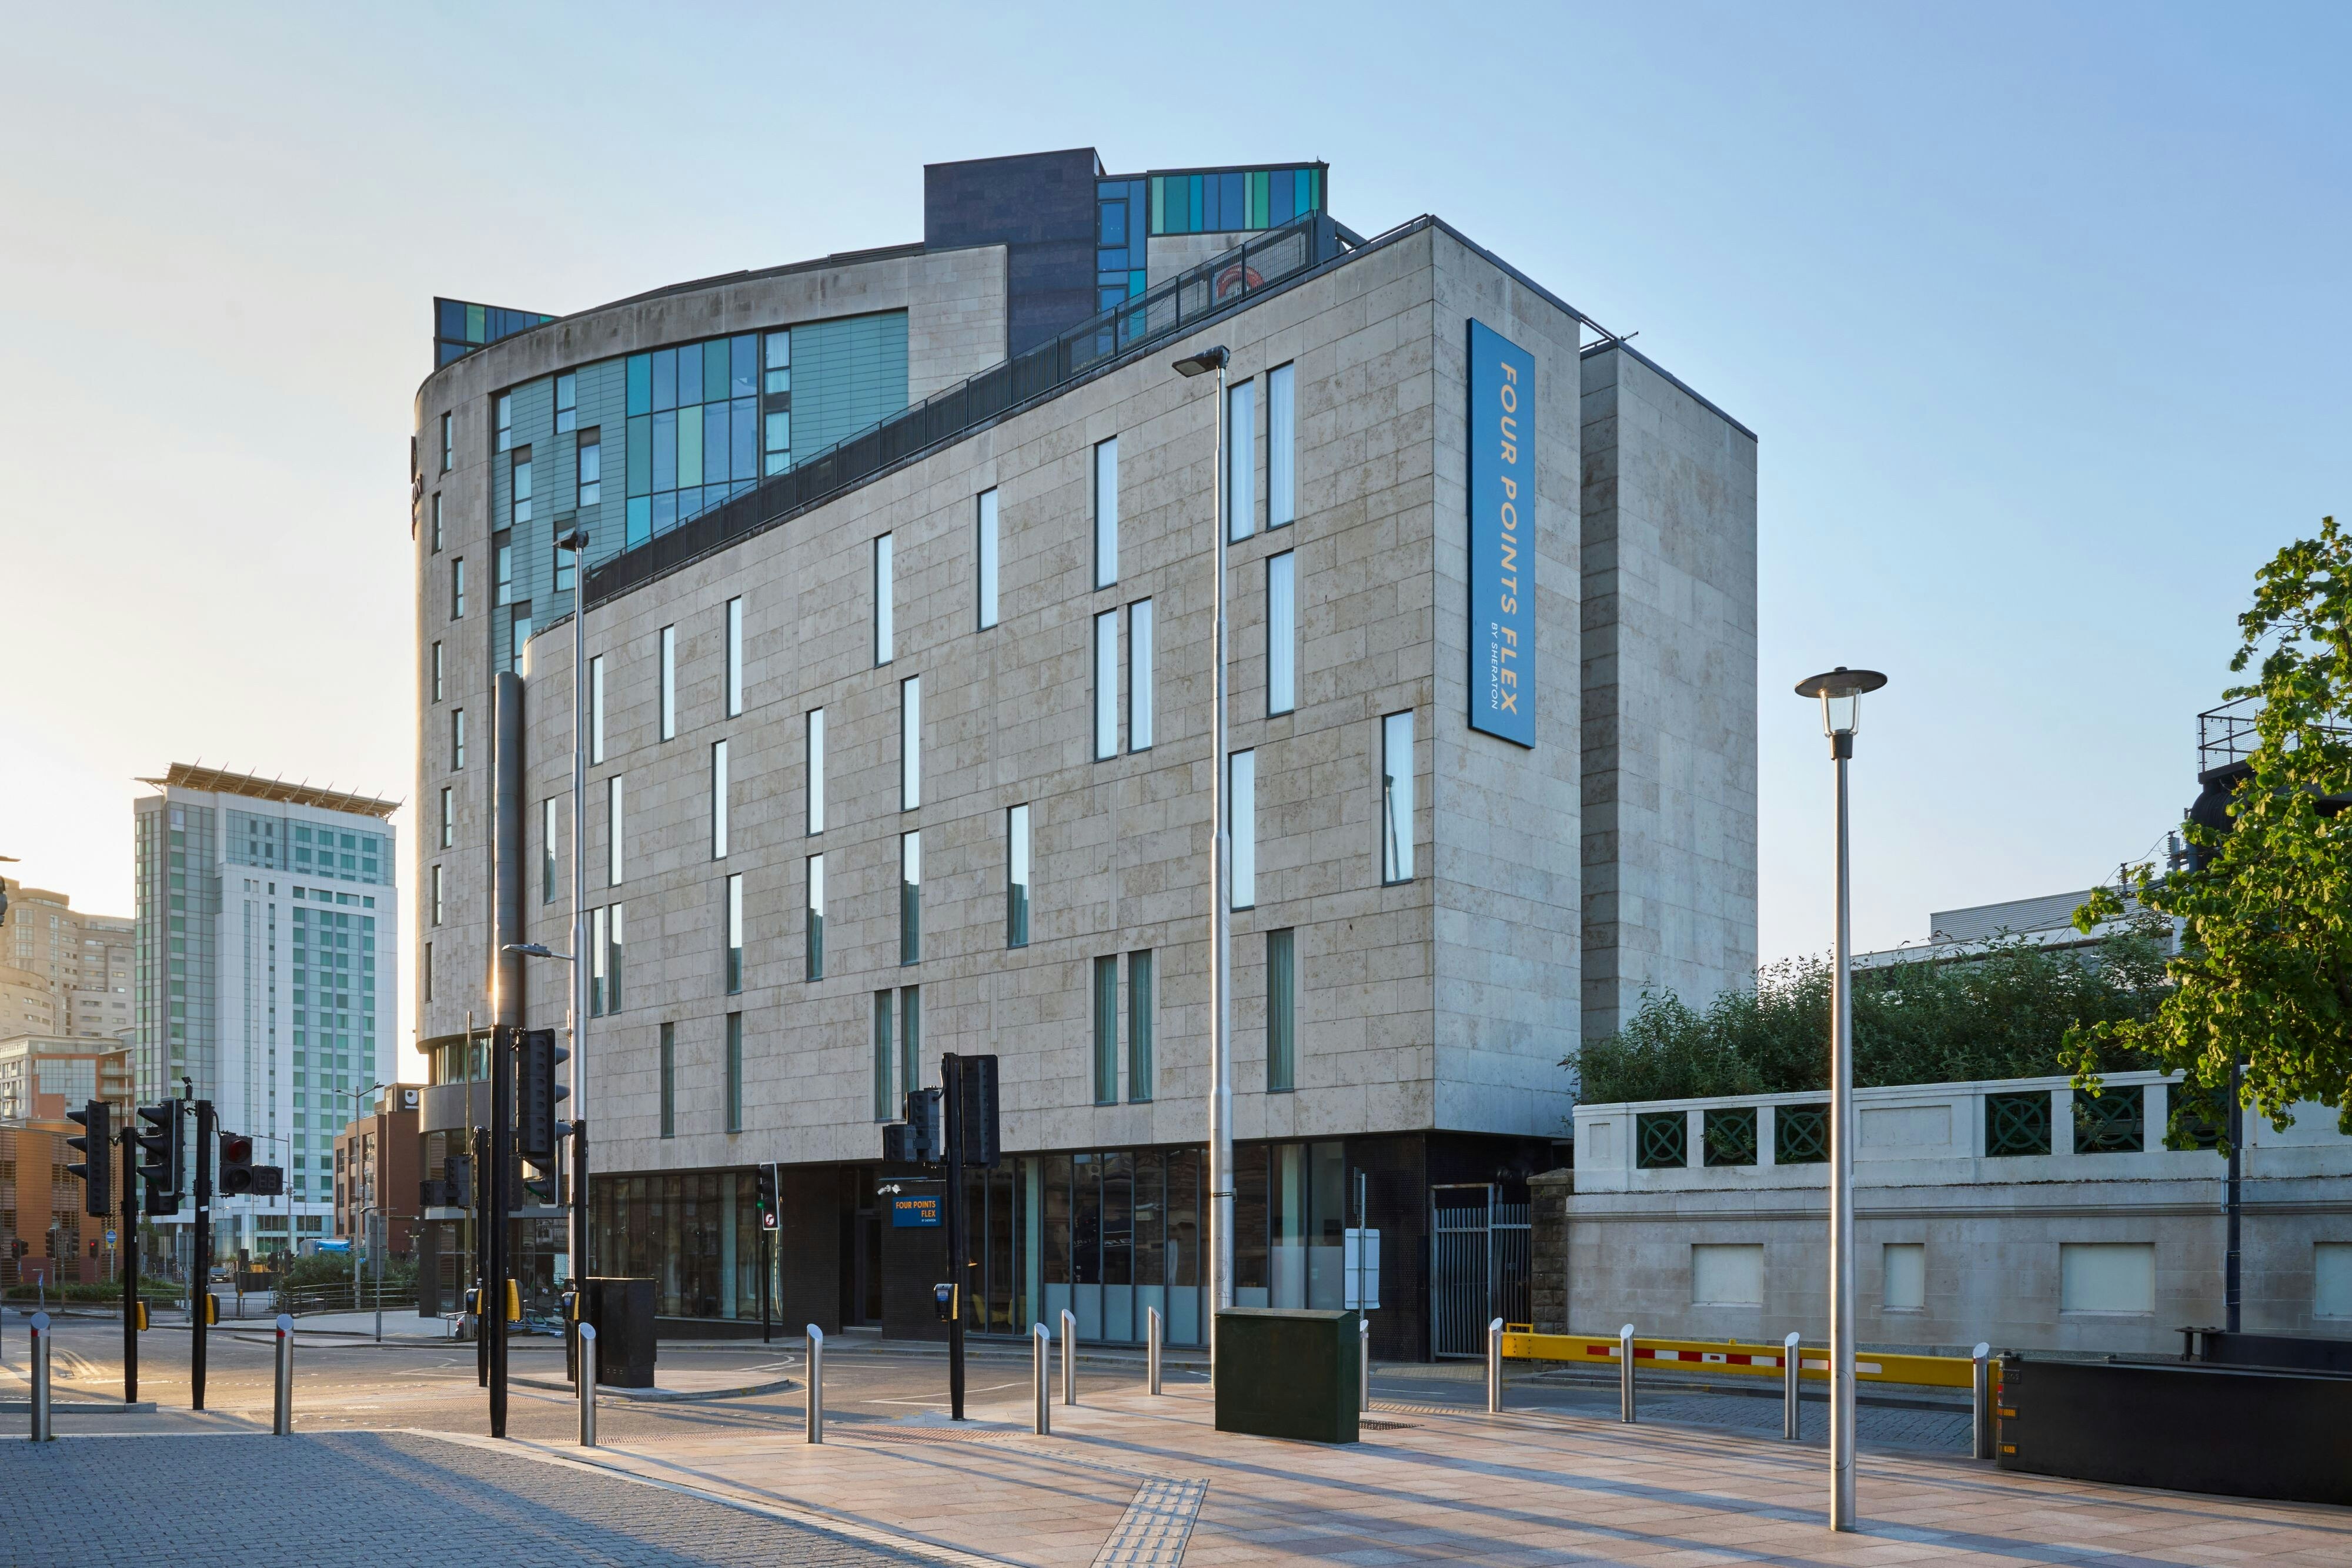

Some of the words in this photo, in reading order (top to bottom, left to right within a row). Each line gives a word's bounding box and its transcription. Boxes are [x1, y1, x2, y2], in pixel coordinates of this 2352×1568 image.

[1501, 362, 1516, 464] FOUR
[1501, 476, 1517, 616] POINTS
[1491, 622, 1498, 639] BY
[1501, 626, 1517, 716] FLEX
